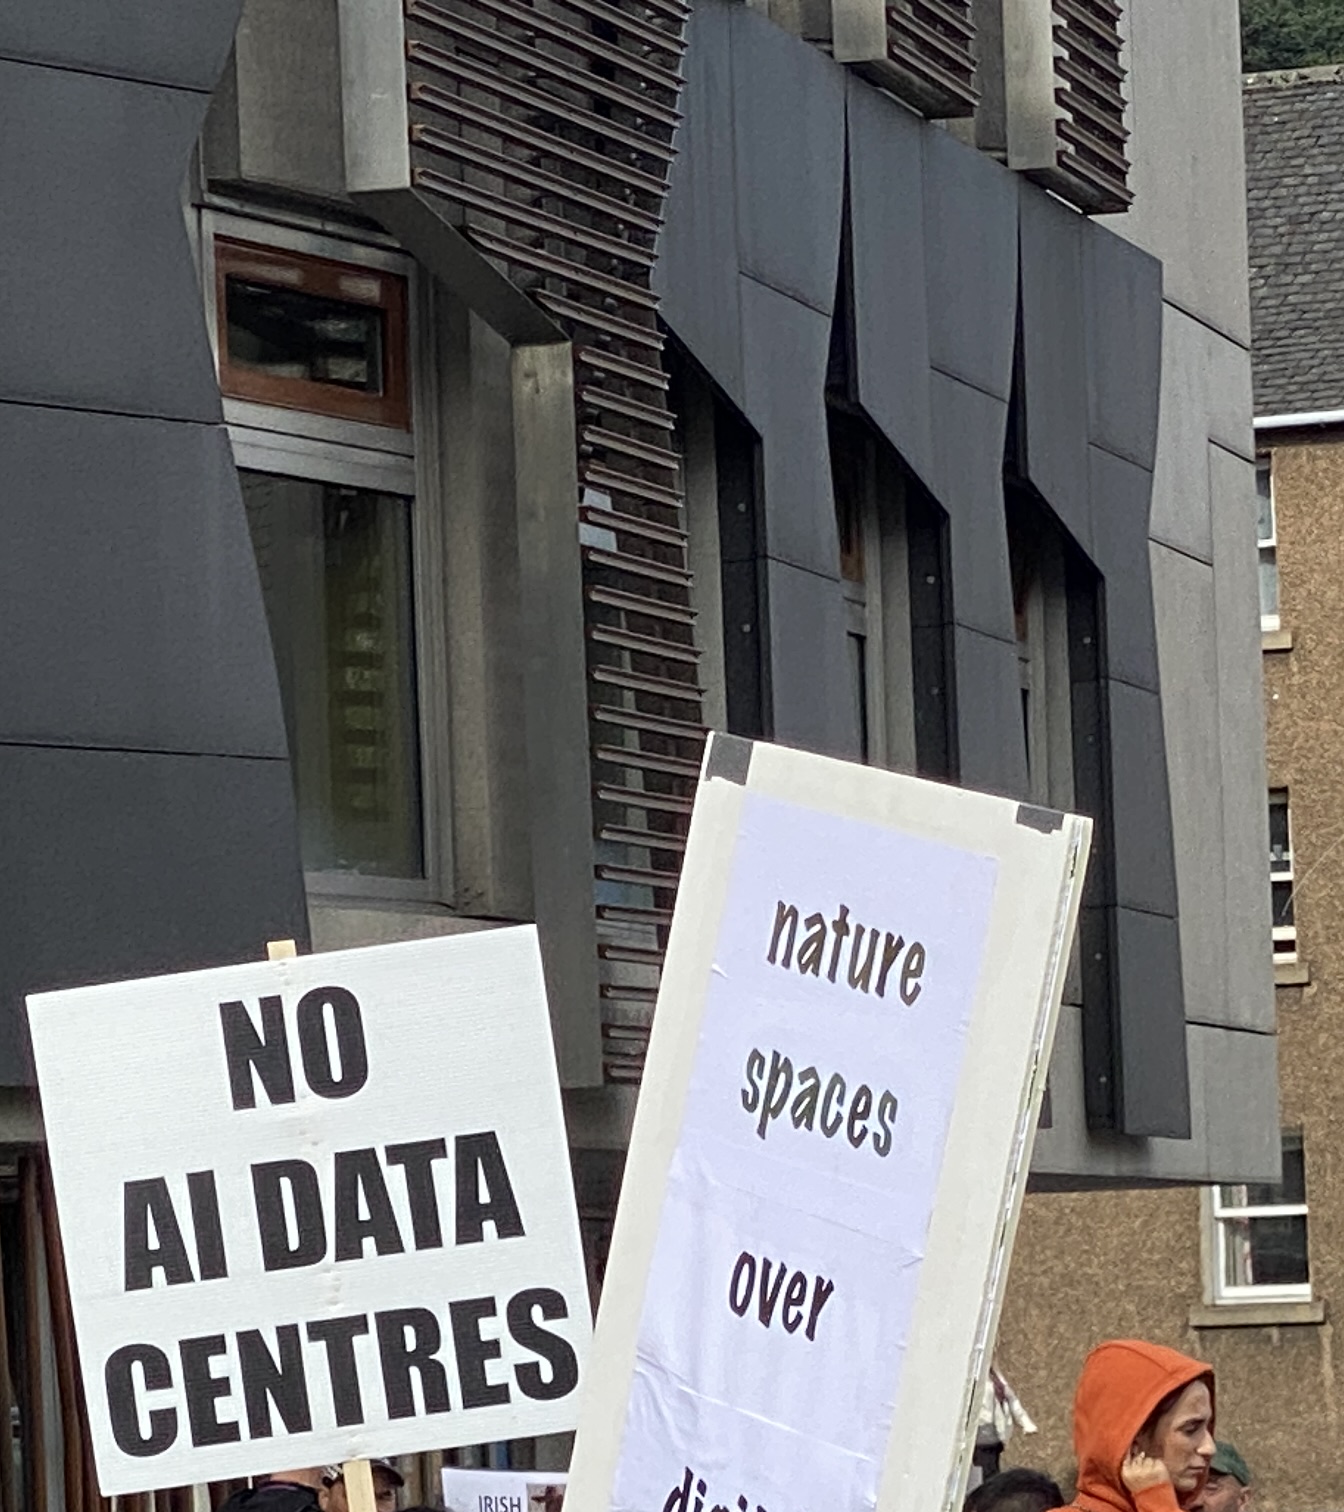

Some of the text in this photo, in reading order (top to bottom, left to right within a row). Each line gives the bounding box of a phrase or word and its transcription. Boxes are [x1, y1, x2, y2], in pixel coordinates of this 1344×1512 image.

[766, 900, 926, 1006] nature
[219, 985, 369, 1111] NO
[741, 1048, 898, 1159] spaces
[123, 1130, 526, 1291] AI DATA
[728, 1250, 835, 1342] over
[103, 1286, 579, 1458] CENTRES
